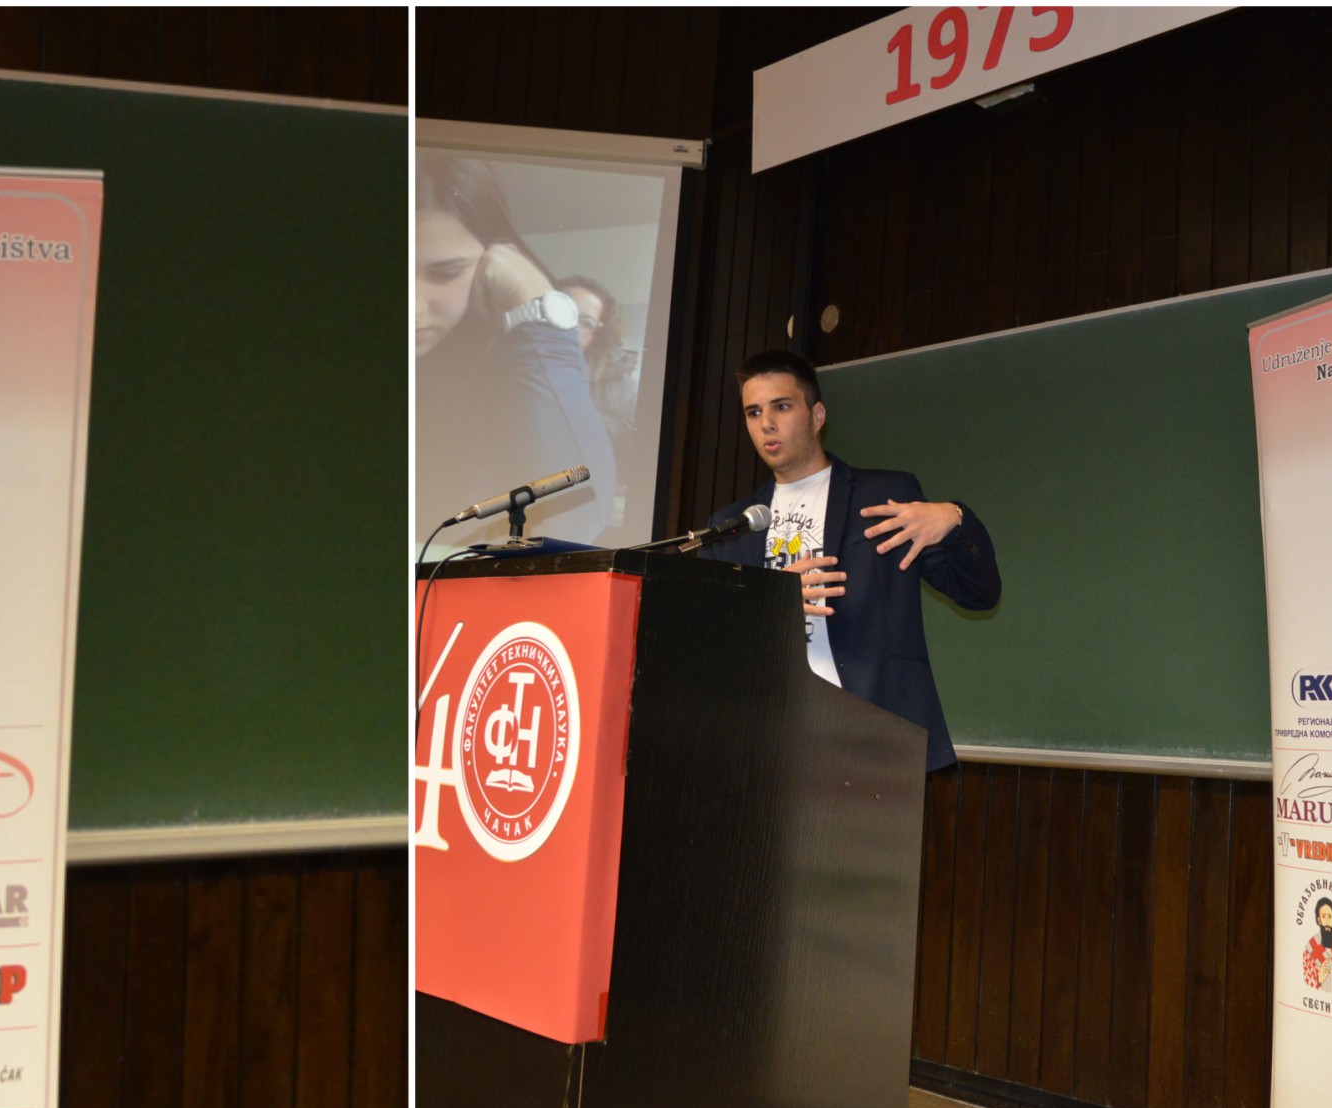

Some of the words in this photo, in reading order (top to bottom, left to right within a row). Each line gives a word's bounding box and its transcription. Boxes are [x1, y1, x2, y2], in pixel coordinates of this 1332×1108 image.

[885, 6, 1074, 106] 1975
[1261, 341, 1332, 374] Udruženje
[464, 658, 498, 753] ФАКУЛТЕТ
[501, 644, 561, 691] ТЕХНИЧКИХ
[554, 692, 568, 764] НАУКА
[484, 807, 533, 837] ЧАЧАК
